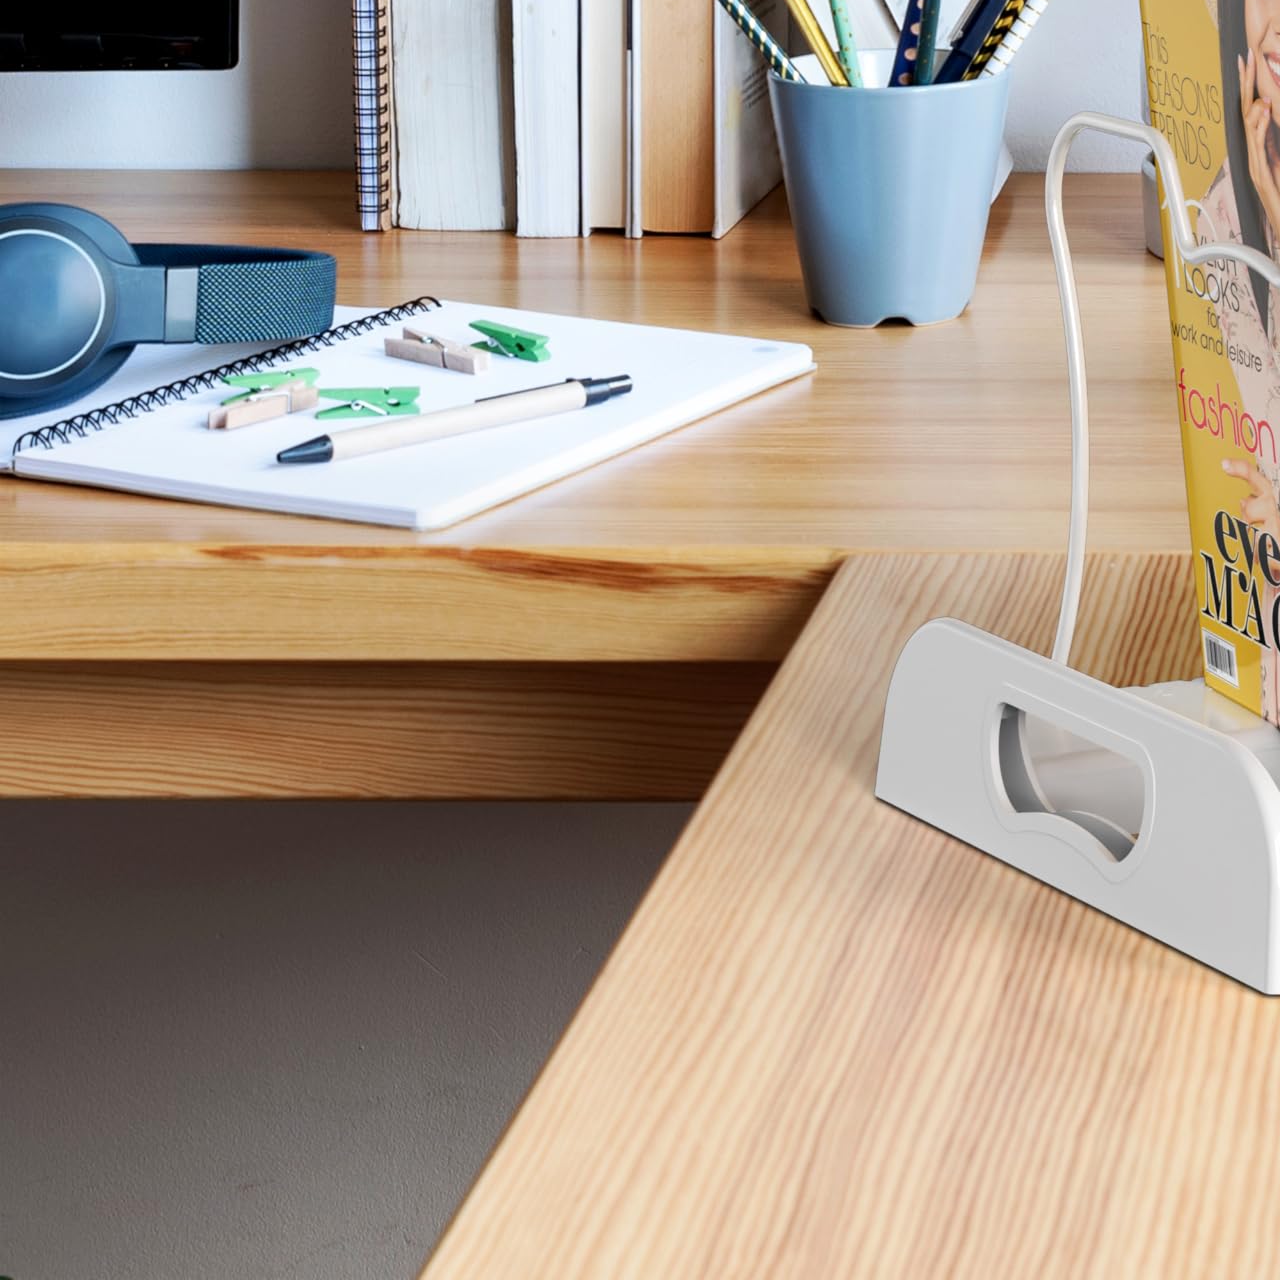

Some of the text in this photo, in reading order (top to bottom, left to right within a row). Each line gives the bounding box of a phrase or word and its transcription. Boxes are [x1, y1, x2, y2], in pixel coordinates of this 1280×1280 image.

[1183, 262, 1241, 314] LOOKS
[1206, 306, 1221, 331] for
[1171, 319, 1263, 373] work and leisure
[1178, 367, 1278, 464] fashion
